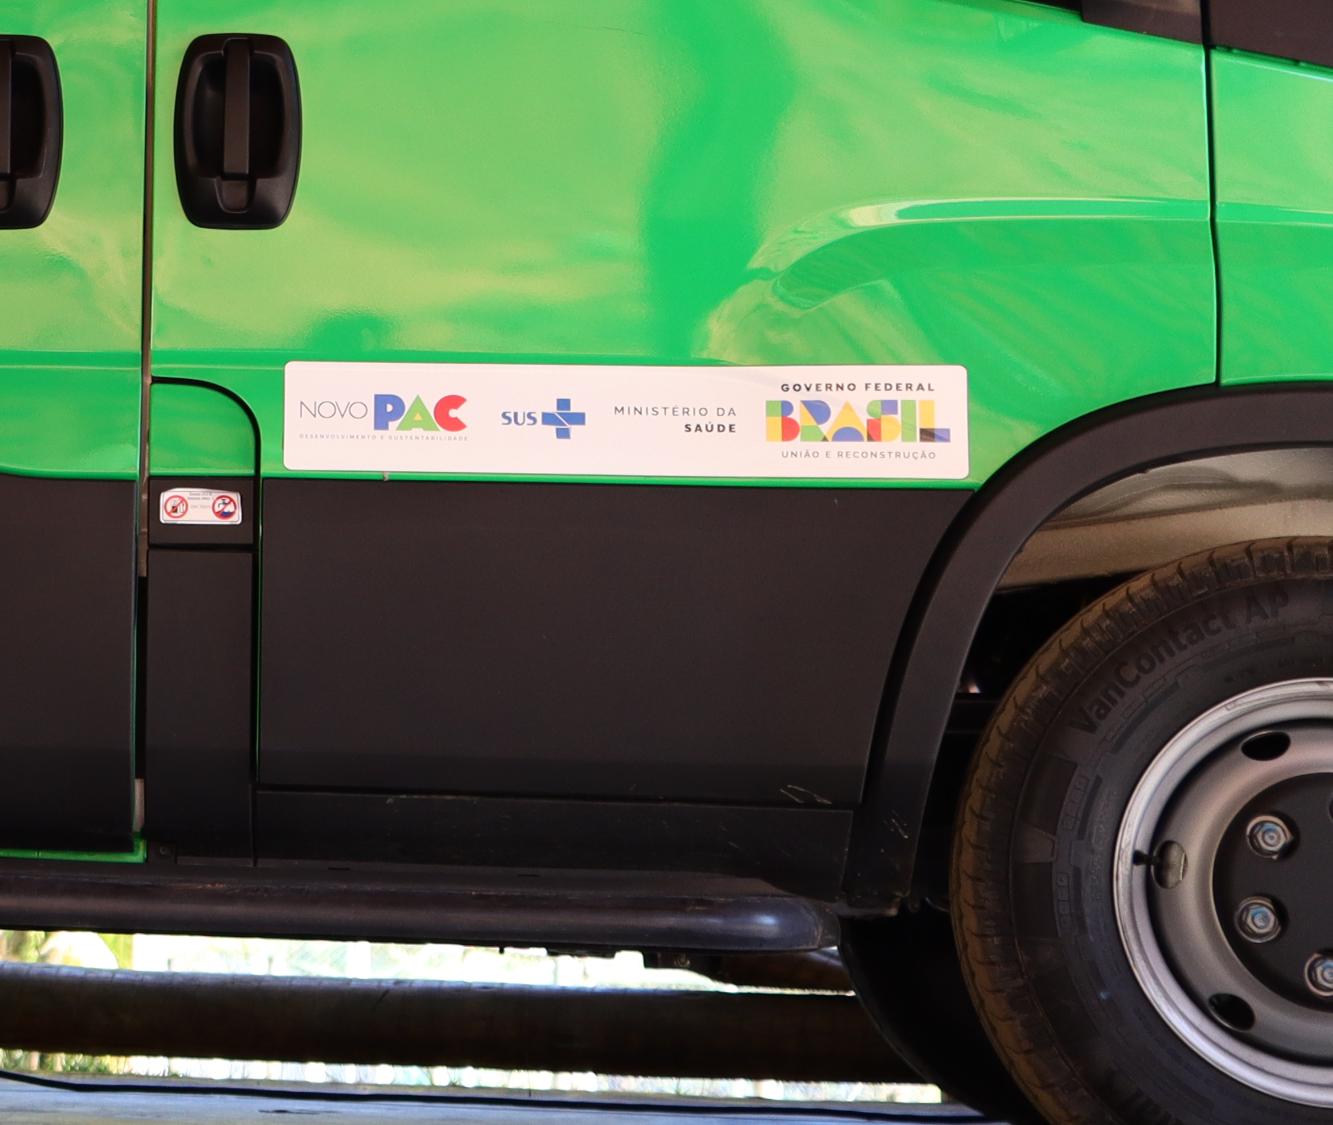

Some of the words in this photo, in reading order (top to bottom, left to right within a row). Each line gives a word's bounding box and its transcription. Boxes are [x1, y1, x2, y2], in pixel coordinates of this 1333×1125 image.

[781, 383, 857, 392] GOVERNO
[865, 383, 935, 392] FEDERAL
[299, 400, 368, 419] NOVO
[373, 394, 468, 432] PAC
[614, 405, 708, 417] MINISTÉRIO
[716, 407, 736, 417] DA
[501, 411, 537, 426] SUS
[766, 399, 951, 443] BRASIL
[684, 421, 736, 433] SAÚDE
[781, 449, 820, 459] UNIÃO
[837, 450, 936, 460] RECONSTRUÇÃO
[1067, 602, 1235, 734] VanContact
[1244, 590, 1289, 625] AP
